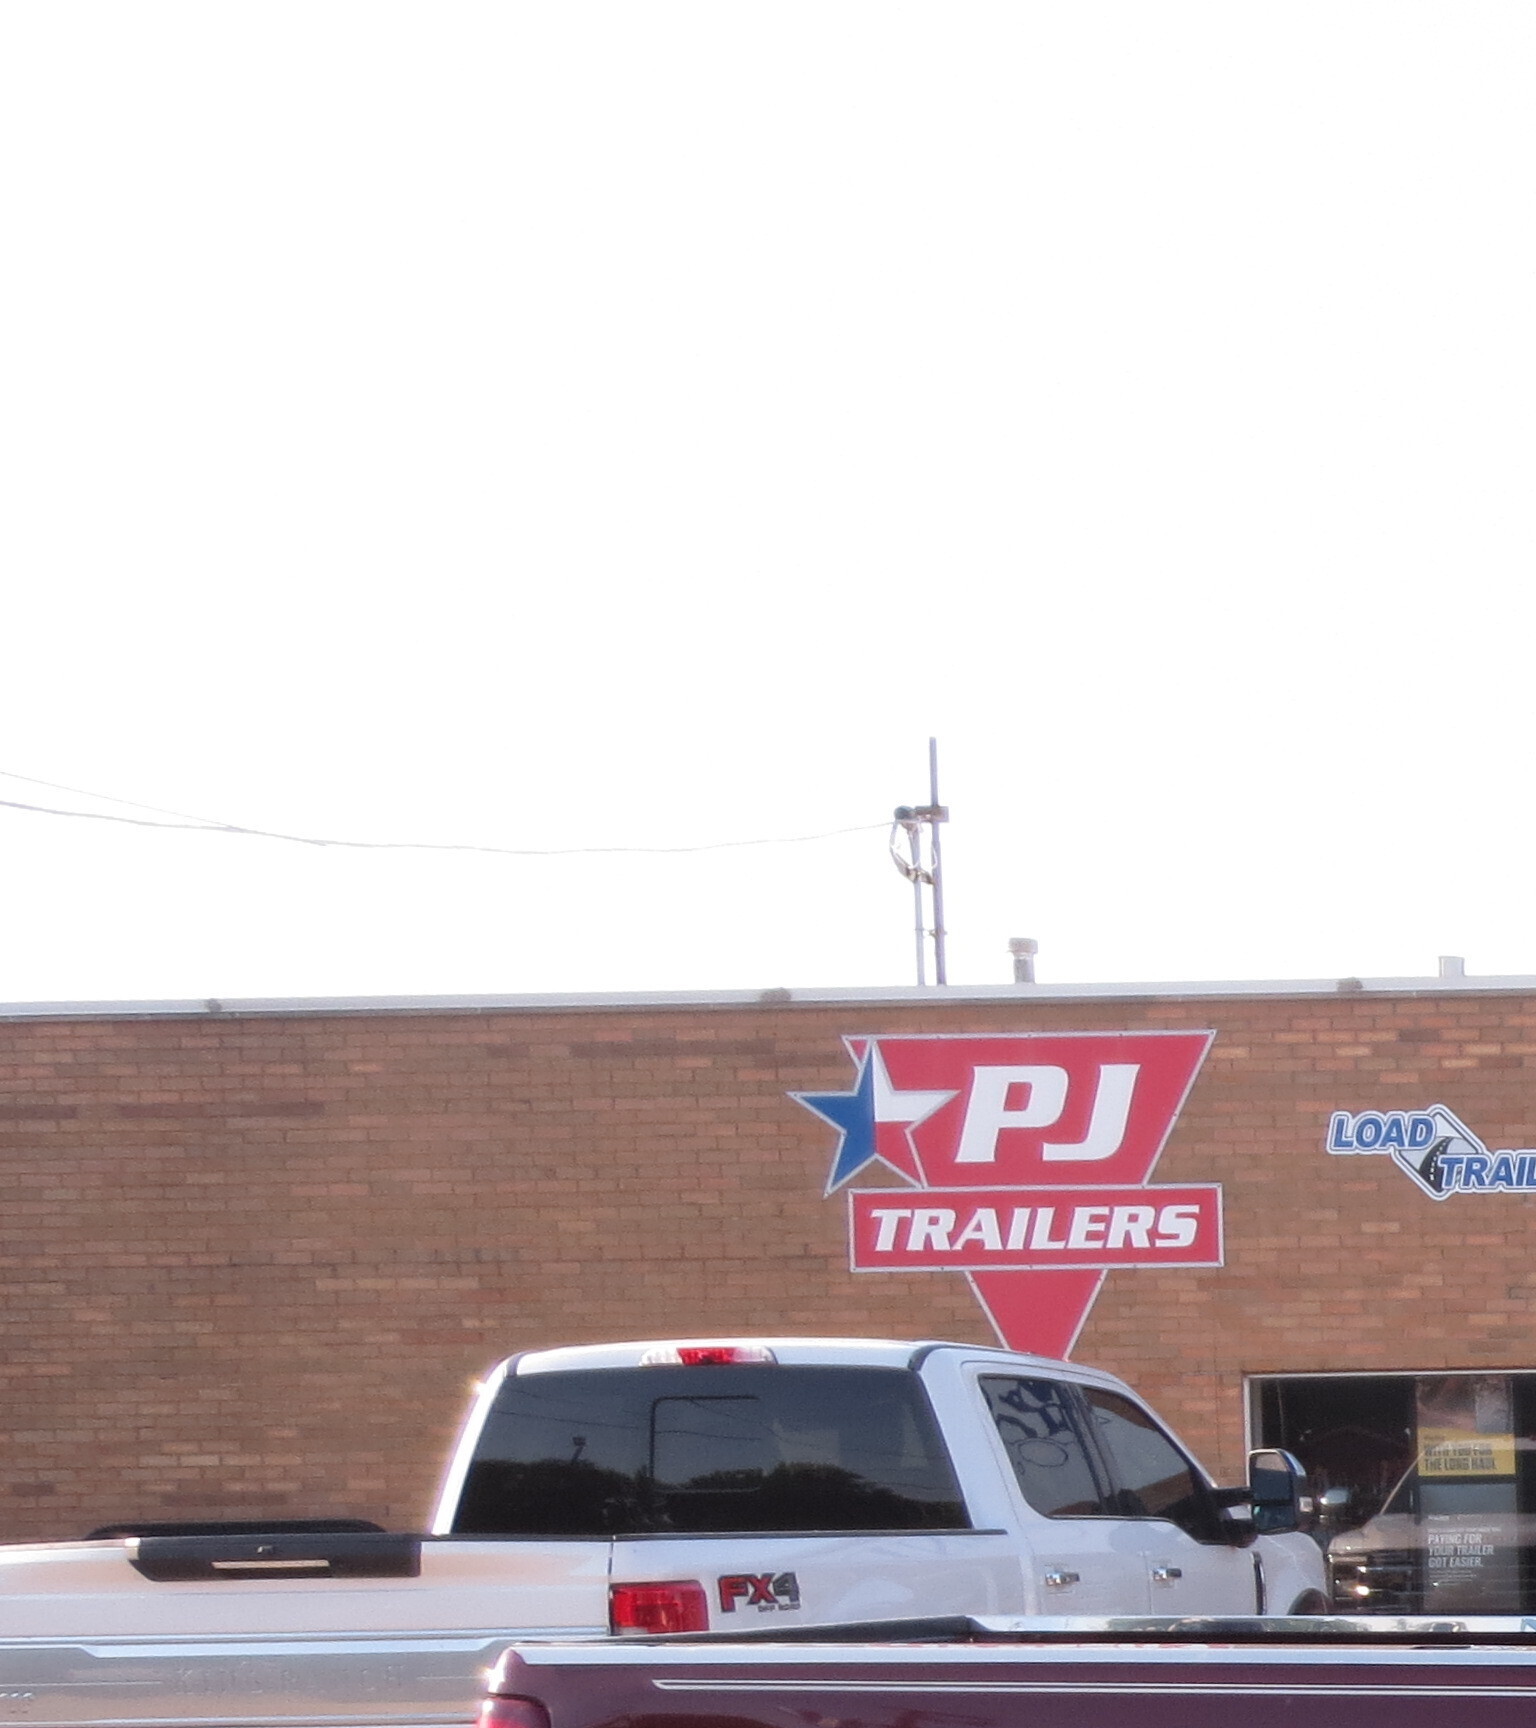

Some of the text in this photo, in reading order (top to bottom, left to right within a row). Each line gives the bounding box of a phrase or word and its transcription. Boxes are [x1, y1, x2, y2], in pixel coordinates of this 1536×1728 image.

[954, 1063, 1142, 1164] PJ
[1332, 1116, 1436, 1149] LOAD
[870, 1204, 1201, 1252] TRAILERS
[716, 1571, 801, 1613] FX4
